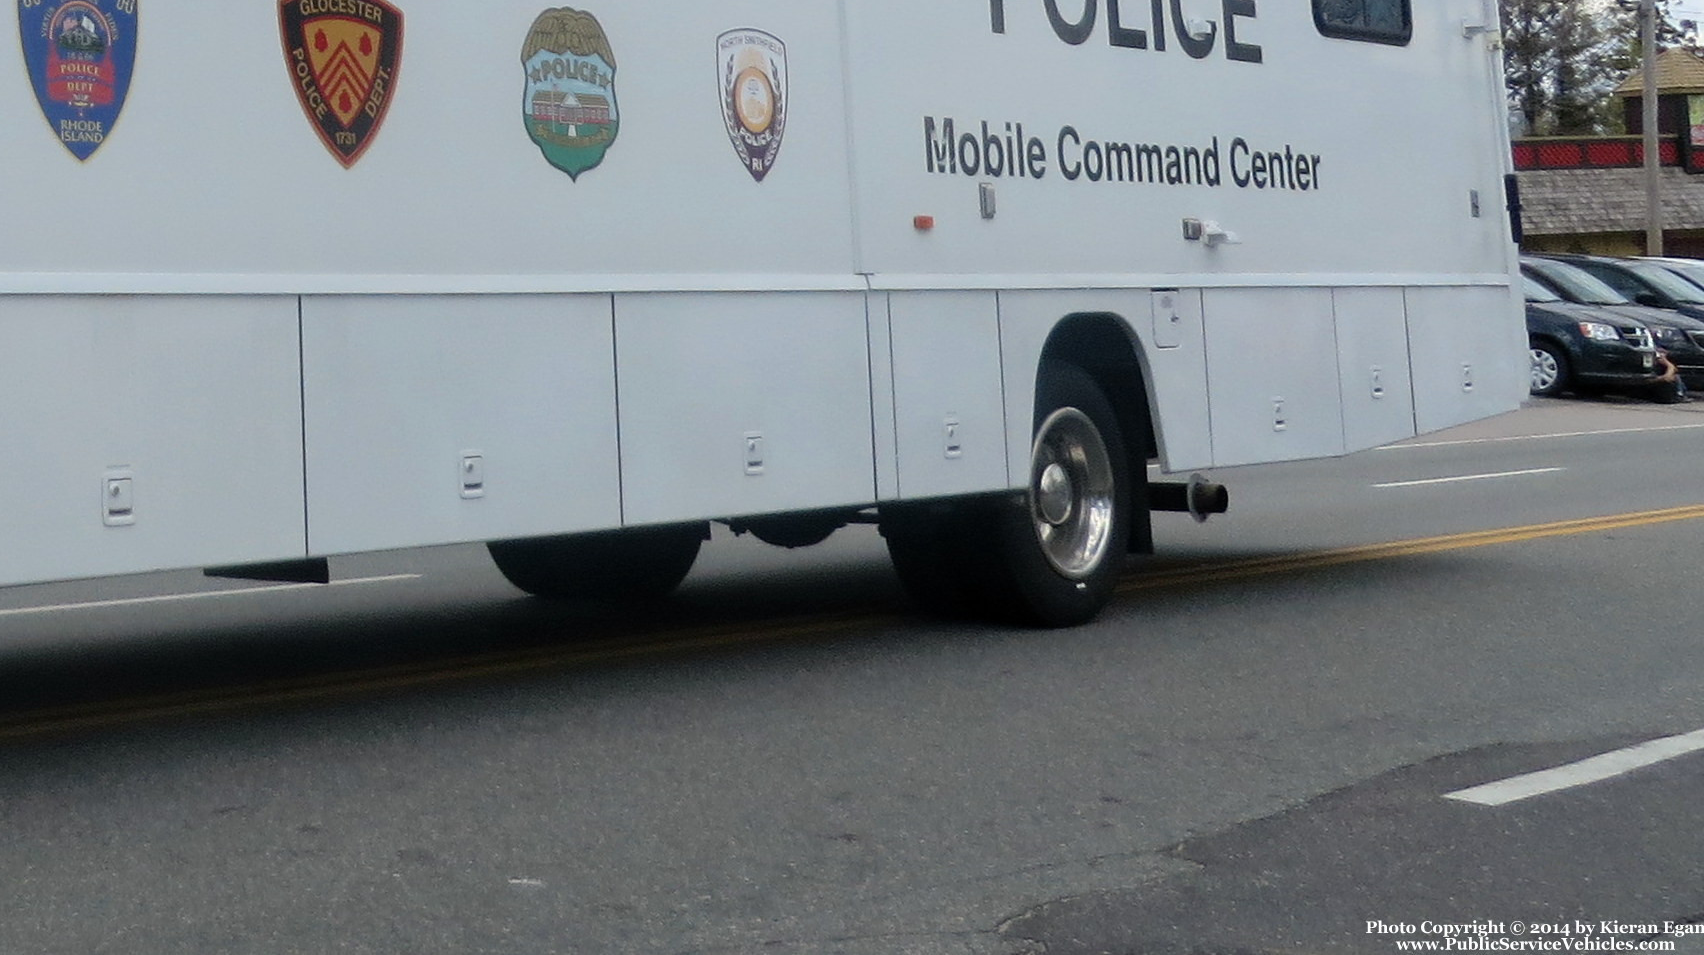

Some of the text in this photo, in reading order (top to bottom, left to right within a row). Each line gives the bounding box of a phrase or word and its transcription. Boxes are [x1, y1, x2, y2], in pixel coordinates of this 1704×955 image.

[60, 63, 100, 77] POLICE
[540, 58, 600, 85] POLICE
[67, 81, 94, 93] DEPT
[293, 47, 328, 120] POLICE
[364, 66, 392, 118] DEPT.
[60, 119, 103, 133] RHODE
[60, 130, 104, 144] ISLAND
[335, 131, 357, 145] 1731
[739, 126, 773, 146] POLICE
[924, 115, 1321, 191] Mobile Command Center
[751, 157, 764, 171] RI
